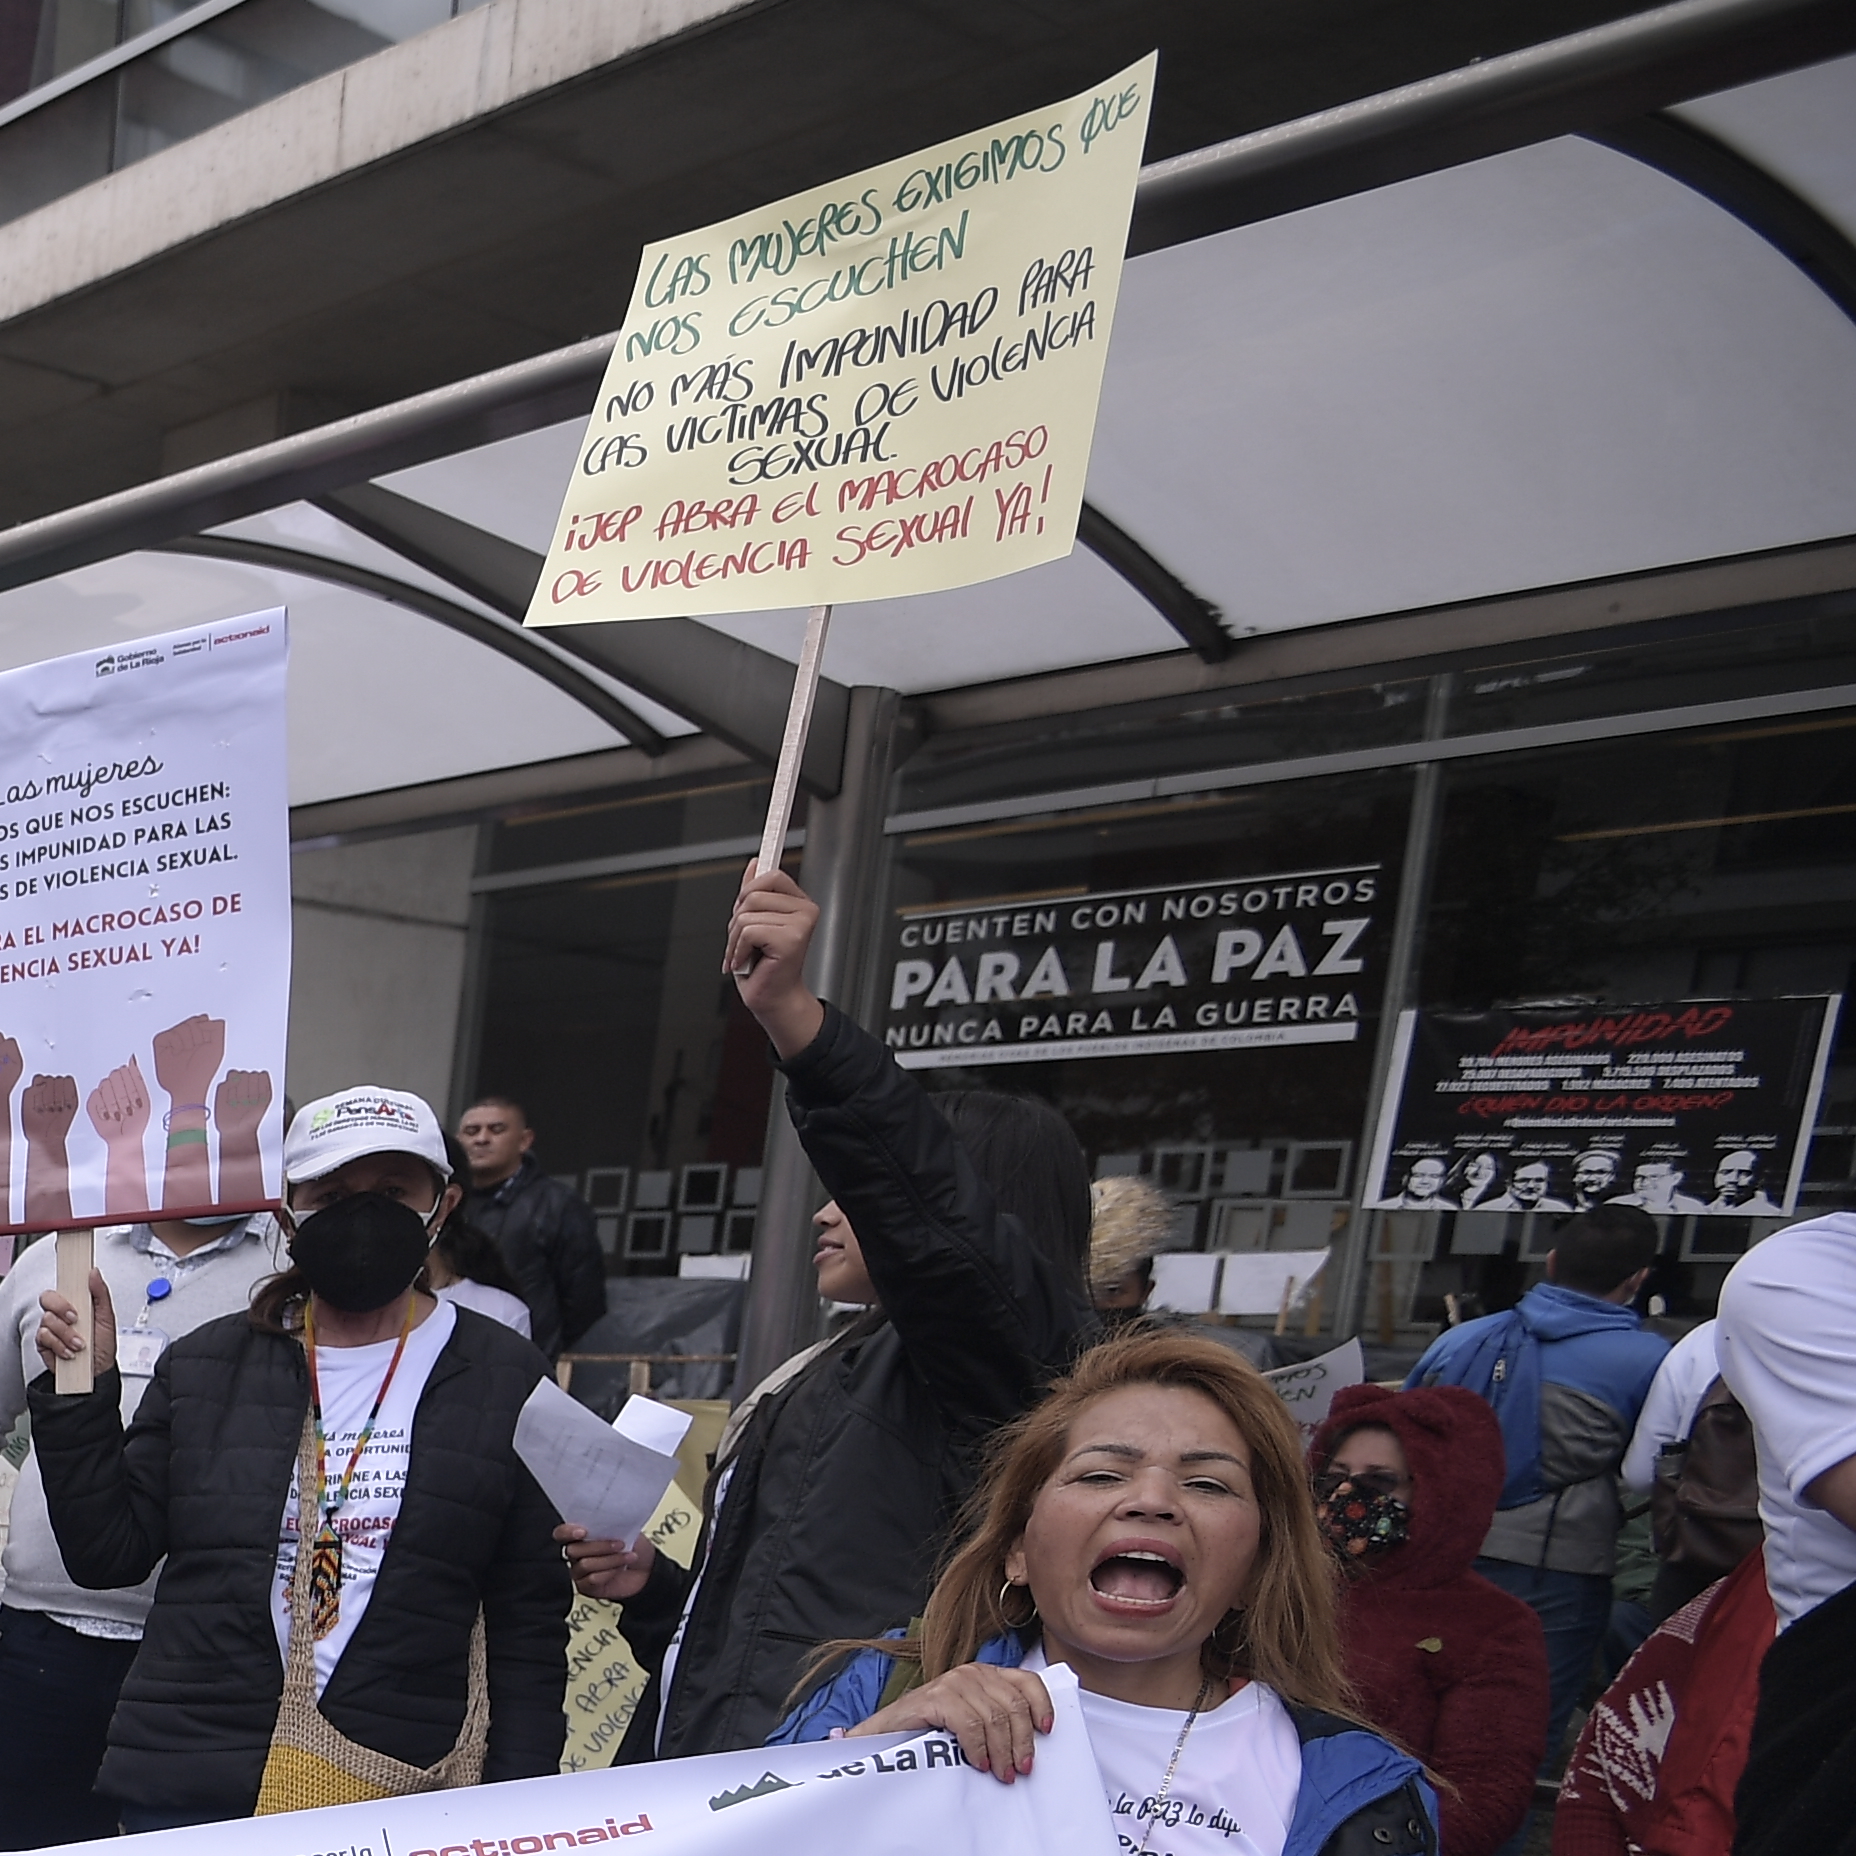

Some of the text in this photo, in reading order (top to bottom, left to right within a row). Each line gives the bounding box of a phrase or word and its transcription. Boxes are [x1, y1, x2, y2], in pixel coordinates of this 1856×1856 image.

[729, 190, 883, 286] MUJERES
[894, 123, 1065, 211] EXIGIMOS
[1081, 83, 1141, 154] QUE
[625, 211, 970, 363] NOS ESCUCHEN
[607, 379, 654, 422] NO
[671, 352, 754, 407] MÁS
[1018, 246, 1096, 317] PARA
[46, 754, 164, 798] mujeres
[25, 812, 64, 836] QUE
[71, 805, 114, 827] NOS
[121, 781, 231, 818] ESCUCHEN:
[15, 832, 126, 868] IMPUNIDAD
[134, 818, 188, 845] PARA
[195, 811, 232, 835] LAS
[14, 878, 38, 898] DE
[44, 859, 150, 892] VIOLENCIA
[156, 844, 239, 873] SEXUAL.
[24, 925, 45, 946] EL
[52, 898, 203, 940] MACROCASO
[212, 893, 242, 916] DE
[900, 878, 1378, 949] CUENTEN CON NOSOTROS
[67, 946, 152, 973] SEXUAL
[161, 934, 202, 958] YA!
[889, 918, 1372, 1011] PARA LA PAZ
[887, 993, 1360, 1047] NUNCA PARA LA GUERRA
